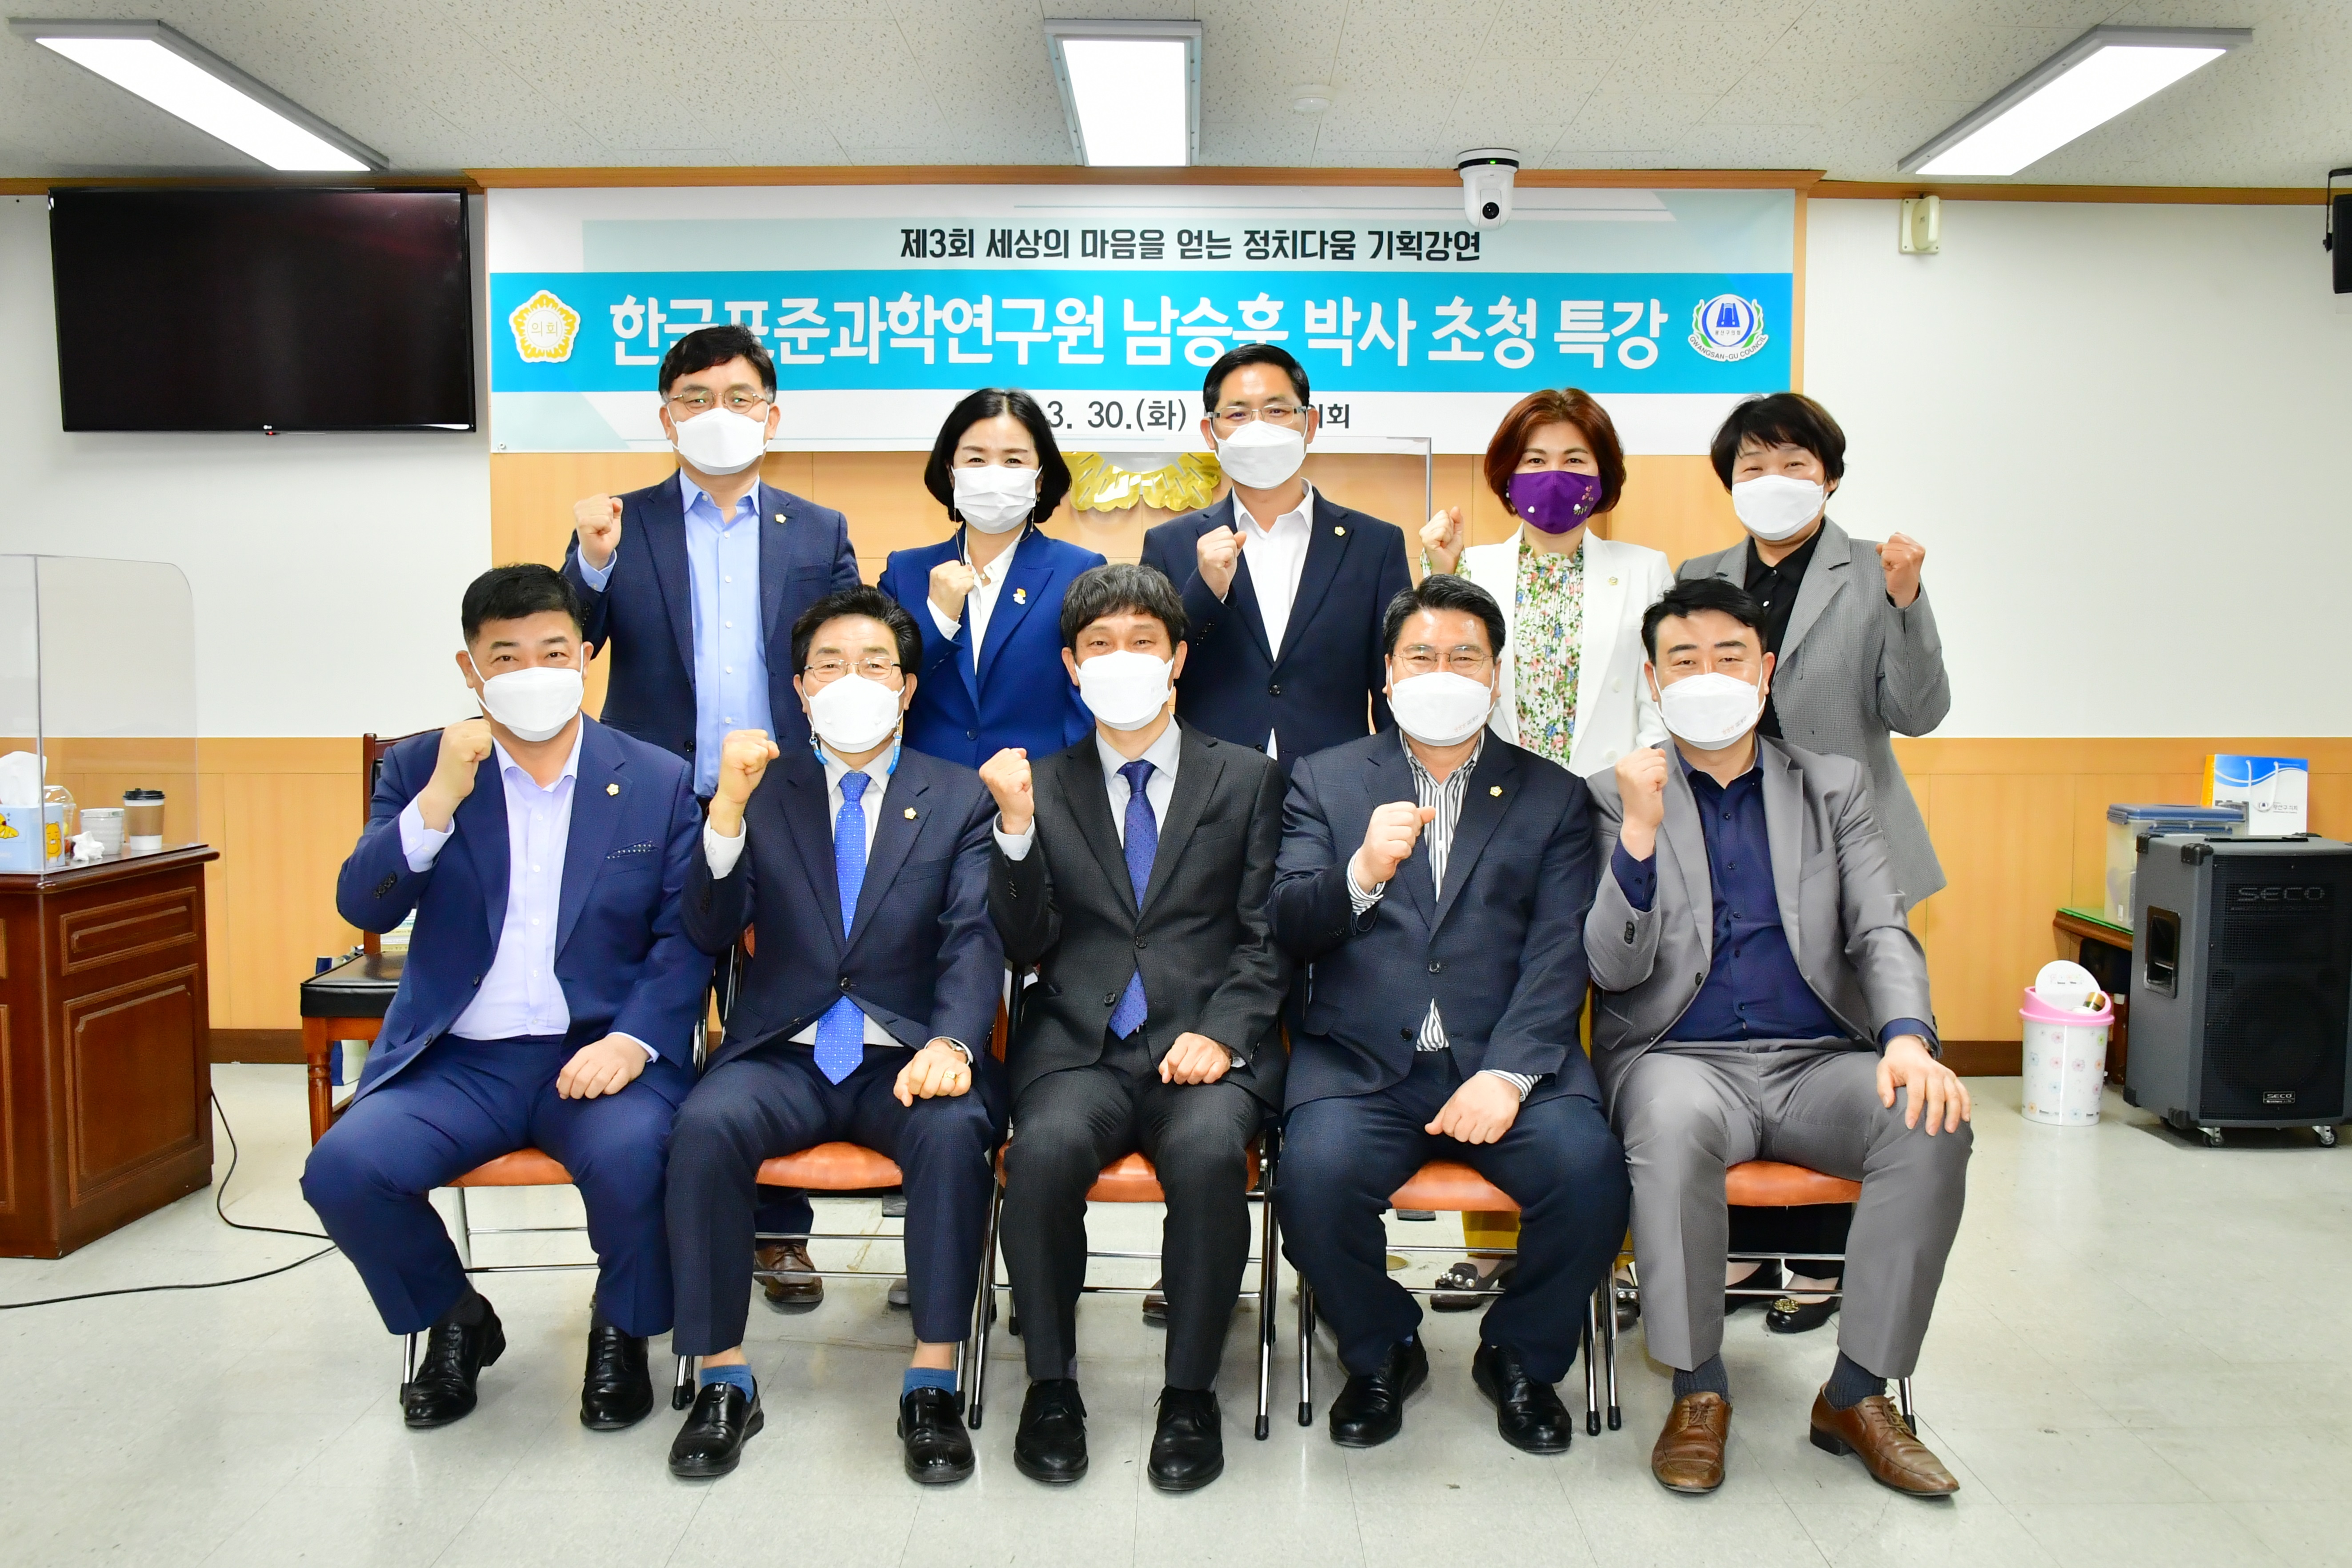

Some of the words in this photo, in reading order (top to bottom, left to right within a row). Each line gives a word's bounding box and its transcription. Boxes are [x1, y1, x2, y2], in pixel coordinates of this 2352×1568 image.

[901, 229, 974, 258] 제3회
[986, 229, 1069, 259] 세상의
[1081, 229, 1165, 260] 마음을
[1177, 229, 1232, 260] 얻는
[1242, 229, 1356, 261] 정치다움
[1367, 230, 1480, 261] 기획강연
[531, 321, 558, 337] 의회
[1305, 296, 1417, 367] 박사
[1428, 295, 1537, 369] 초청
[1554, 298, 1668, 370] 특강
[1690, 336, 1739, 360] GWANGSAN-GU
[1740, 336, 1766, 357] COUNCIL
[2238, 887, 2325, 901] SECO
